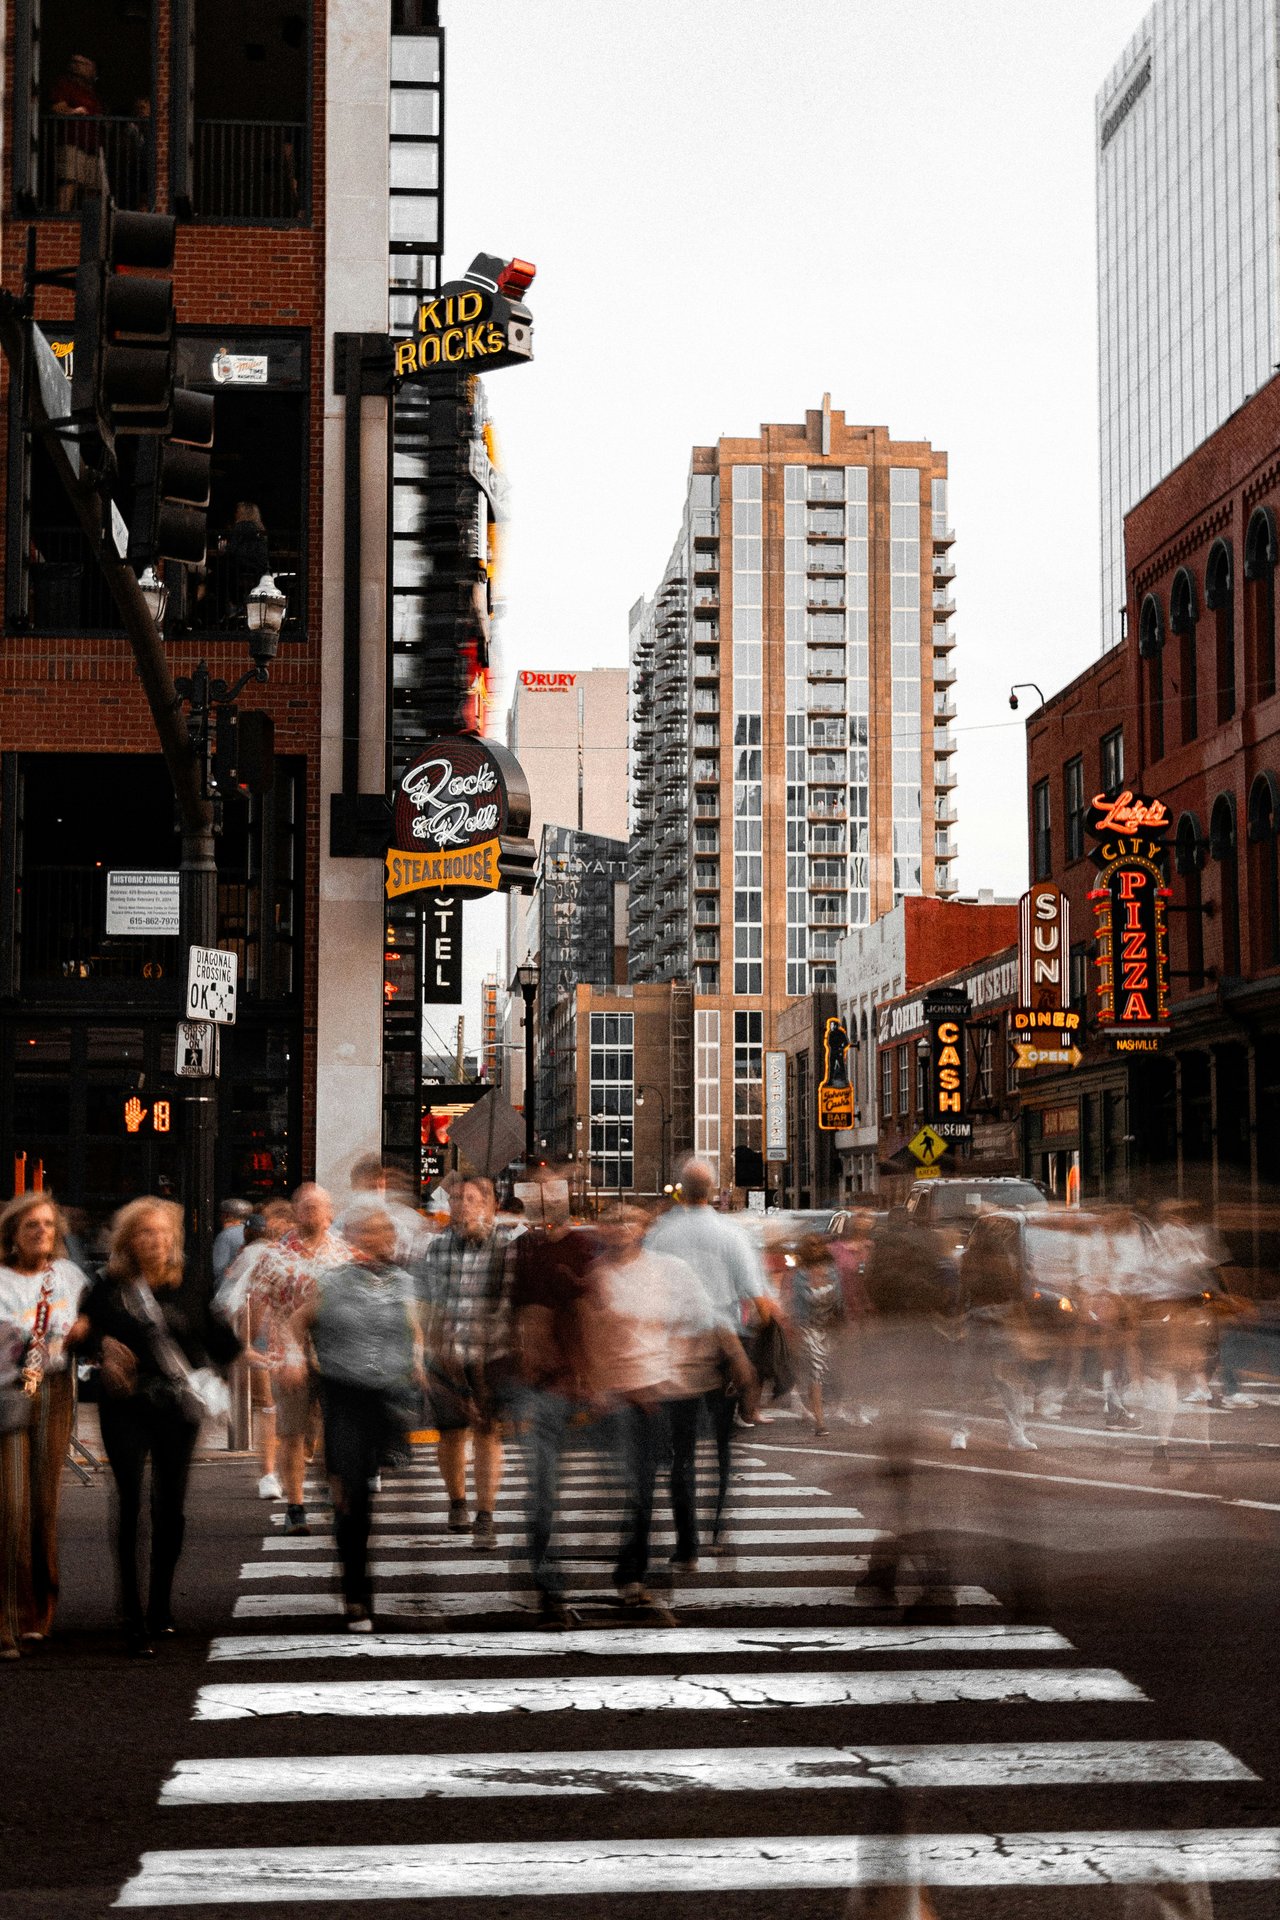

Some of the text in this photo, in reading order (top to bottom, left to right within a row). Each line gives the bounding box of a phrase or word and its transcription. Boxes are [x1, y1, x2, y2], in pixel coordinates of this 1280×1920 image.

[418, 290, 483, 332] KID
[394, 321, 506, 376] ROCK's
[520, 671, 576, 686] DRURY
[401, 759, 498, 810] Rock
[428, 802, 500, 847] Roll
[1102, 838, 1161, 860] CITY
[392, 847, 493, 889] STEAKHOUSE
[113, 875, 144, 885] HISTORIC
[144, 876, 168, 884] ZONING
[129, 917, 179, 925] 615-862-7970
[434, 897, 455, 986] TEL
[1035, 893, 1060, 984] SUN
[1118, 871, 1151, 1020] PIZZA
[197, 950, 232, 969] DIAGONAL
[197, 964, 231, 983] CROSSING
[190, 982, 209, 1010] OK
[926, 1004, 969, 1014] JOHNNY
[182, 1024, 208, 1034] CROSS
[1015, 1011, 1080, 1029] DINER
[184, 1032, 205, 1041] ONLY
[189, 1039, 200, 1049] ON
[1116, 1039, 1158, 1050] NASHVILLE
[1028, 1051, 1069, 1062] OPEN
[180, 1065, 205, 1075] SIGNAL
[937, 1022, 961, 1112] CASH
[154, 1101, 170, 1131] 18
[827, 1113, 848, 1121] BAR
[930, 1123, 972, 1136] MUSEUM
